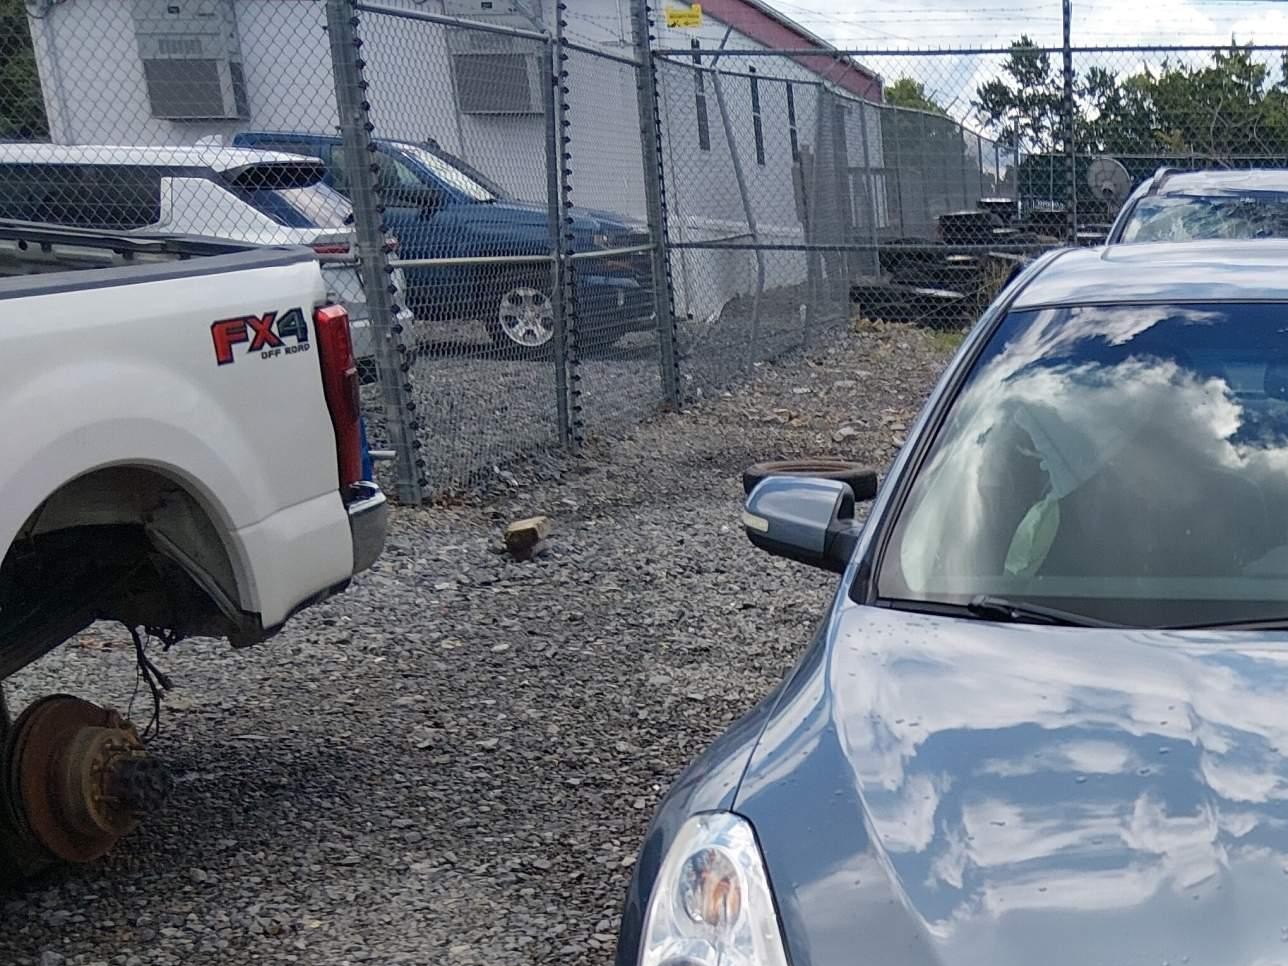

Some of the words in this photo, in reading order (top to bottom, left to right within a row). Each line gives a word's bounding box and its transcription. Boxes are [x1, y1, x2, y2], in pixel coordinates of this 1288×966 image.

[210, 307, 308, 366] FX4
[261, 349, 281, 359] OFF
[285, 343, 311, 355] ROAD
